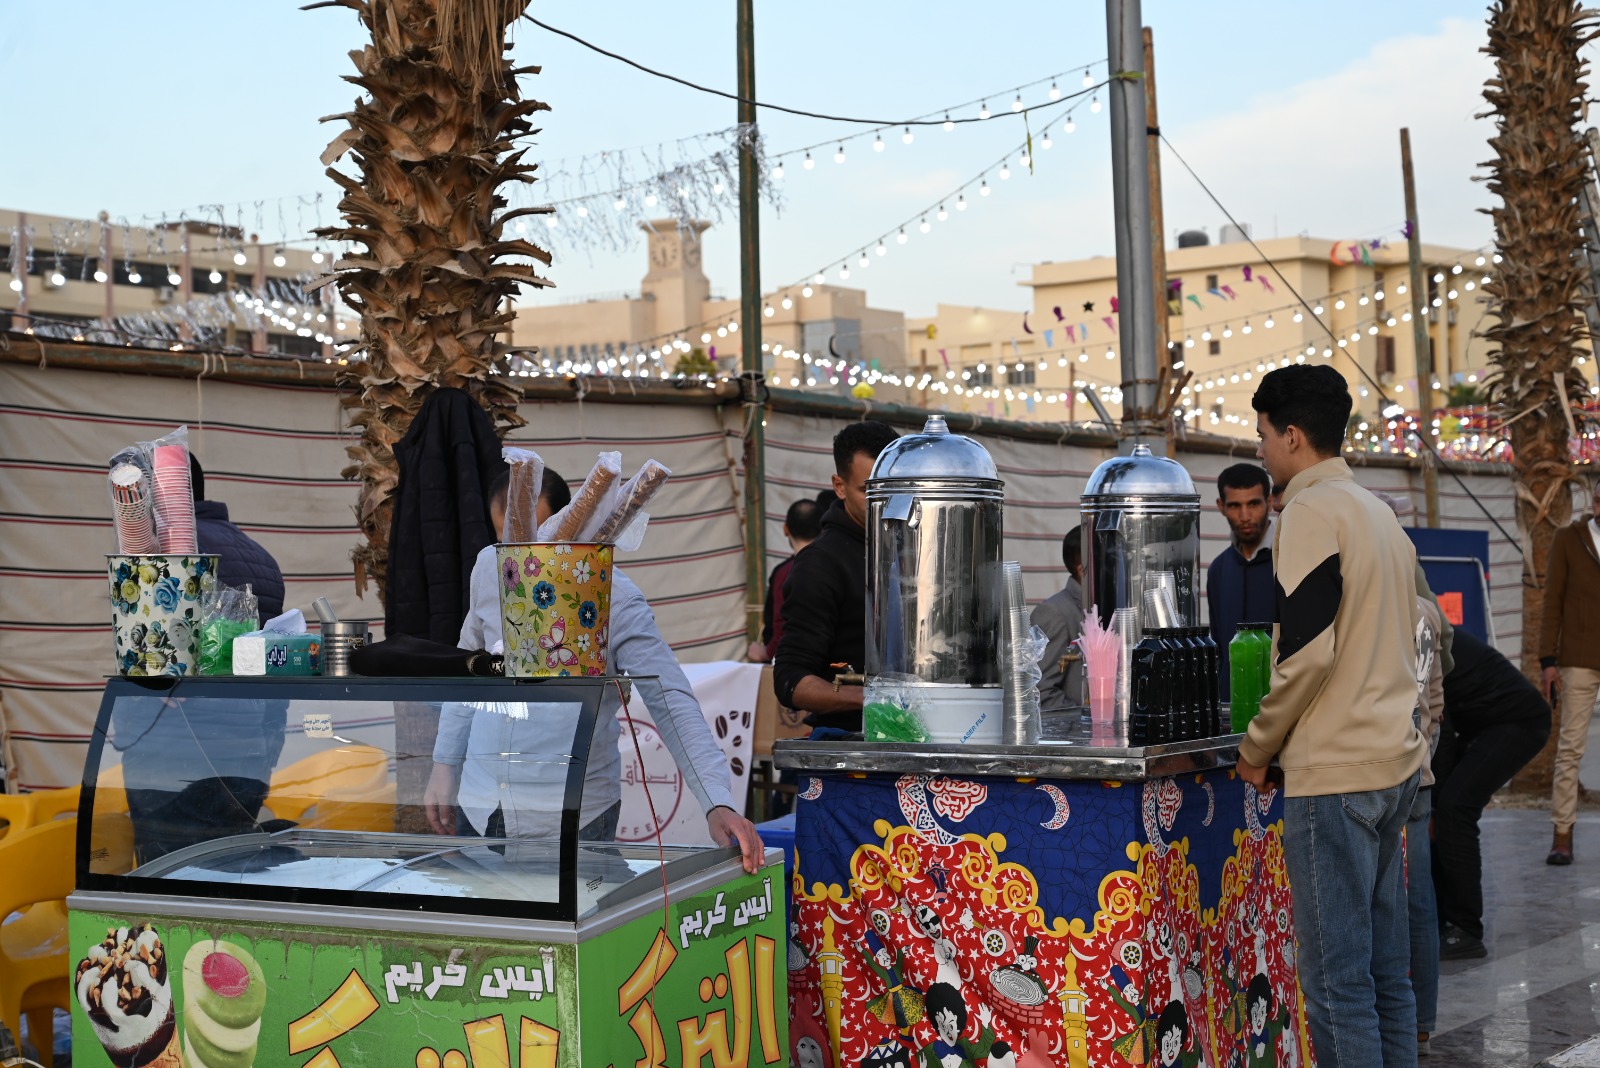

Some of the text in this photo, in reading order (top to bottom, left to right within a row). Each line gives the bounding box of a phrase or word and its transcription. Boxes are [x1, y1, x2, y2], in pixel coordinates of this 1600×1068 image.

[959, 712, 987, 744] LASER FILM
[679, 875, 773, 950] آيس كريم
